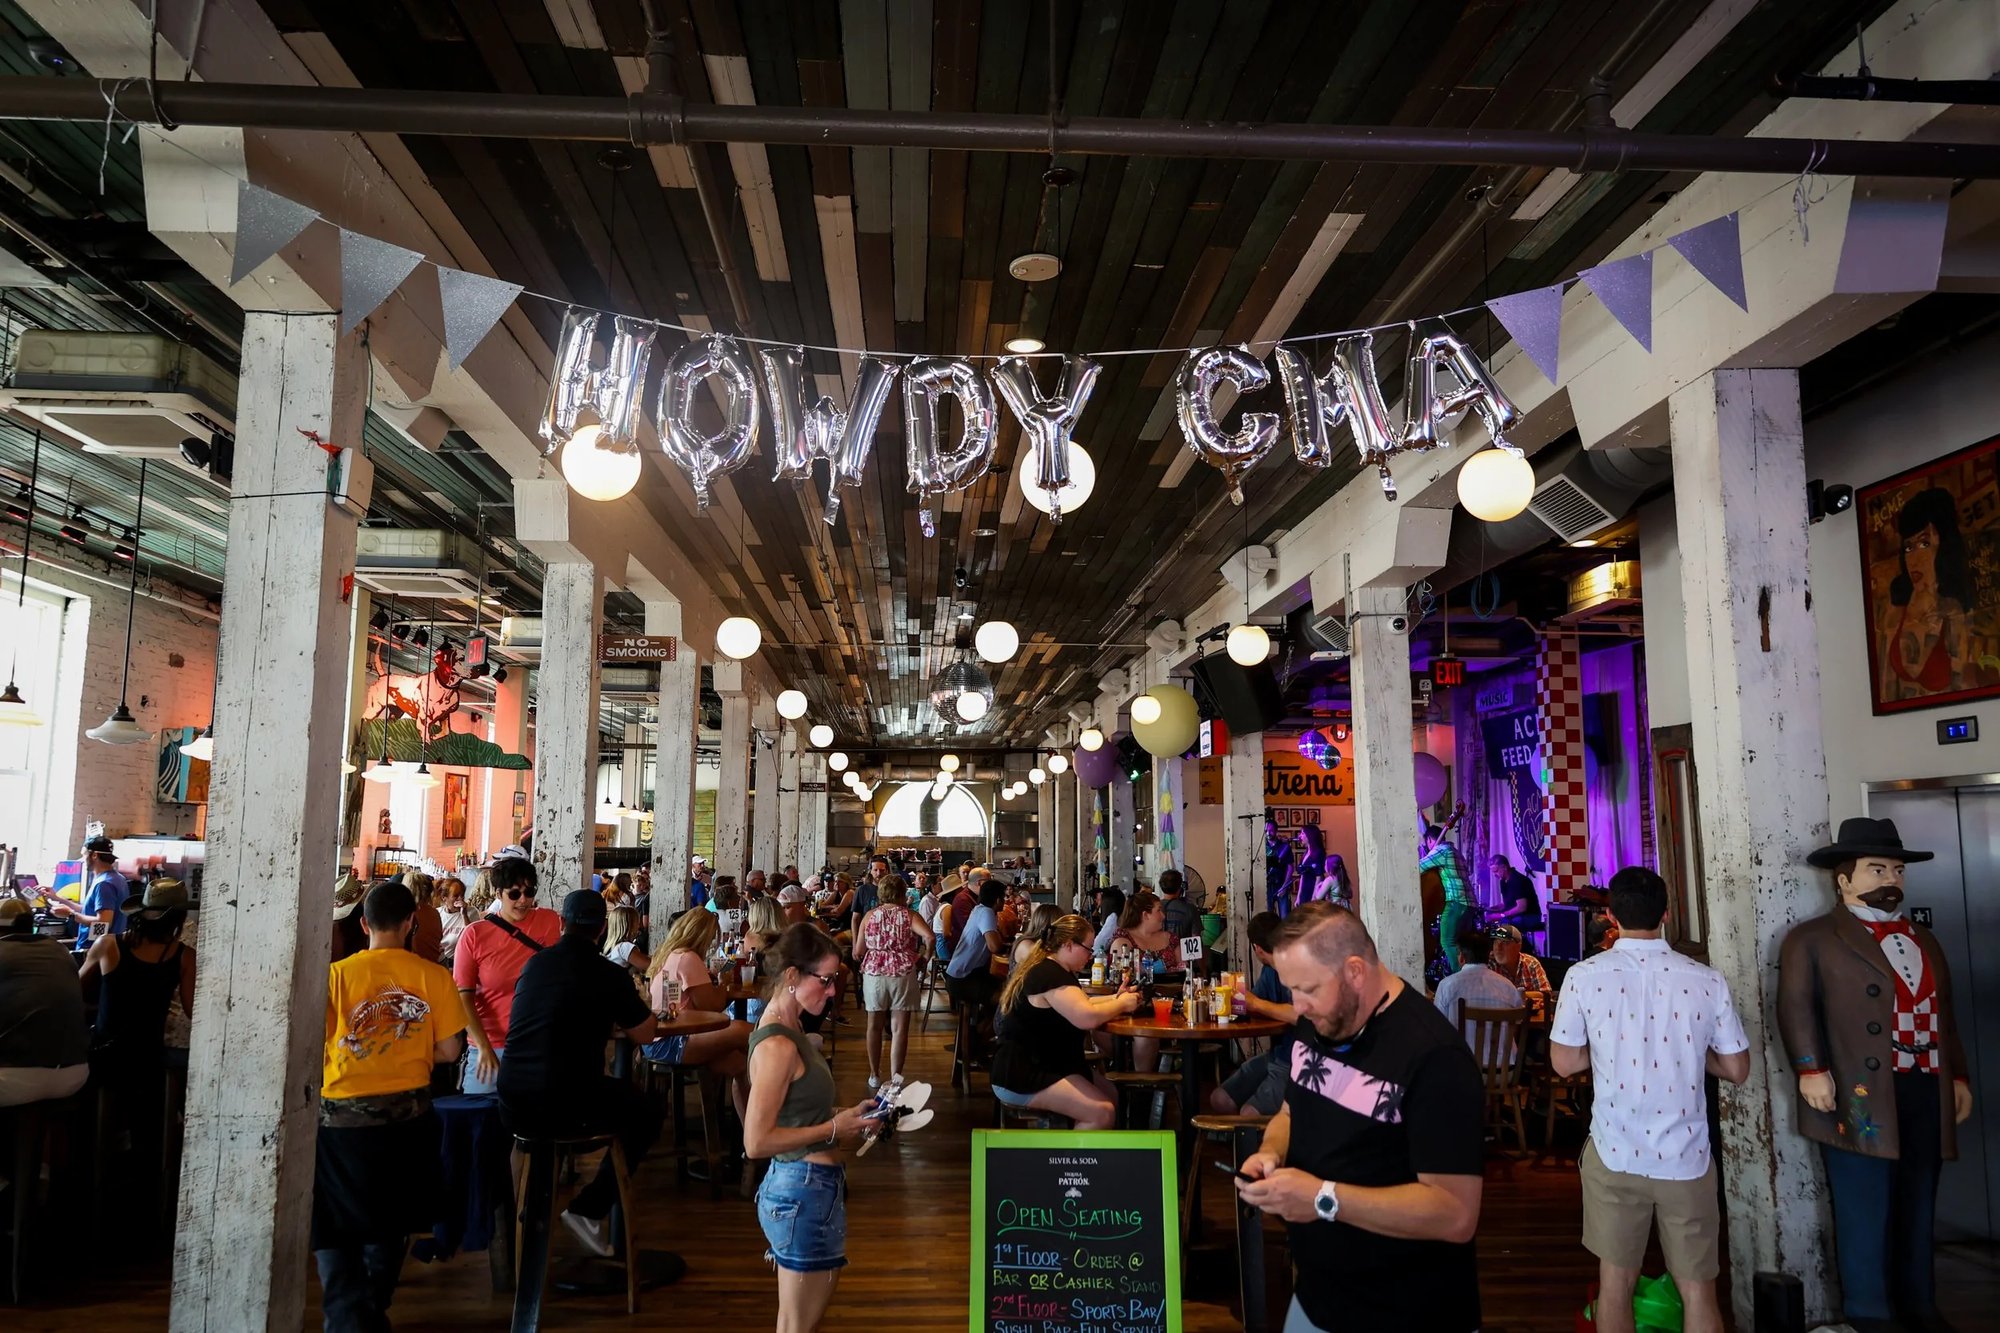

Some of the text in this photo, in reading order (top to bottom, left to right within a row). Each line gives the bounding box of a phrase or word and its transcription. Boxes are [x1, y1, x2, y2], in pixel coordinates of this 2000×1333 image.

[538, 305, 1525, 495] HOWDY CMA
[605, 647, 667, 657] SMOKING
[624, 638, 650, 647] NO
[1436, 662, 1463, 684] EXIT
[1480, 692, 1509, 706] MUSIC
[1502, 745, 1532, 768] FEED
[1264, 759, 1343, 797] trena
[728, 910, 740, 920] 125
[1184, 938, 1199, 954] 102
[1048, 1157, 1098, 1165] SILVER & SODA
[997, 1198, 1142, 1227] OPEN SEATING
[1073, 1247, 1125, 1269] ORDER
[1128, 1251, 1144, 1272] @
[993, 1269, 1022, 1287] BAR
[1029, 1273, 1050, 1290] OR
[1053, 1272, 1115, 1290] CASHIER
[1070, 1298, 1127, 1319] SPORTS
